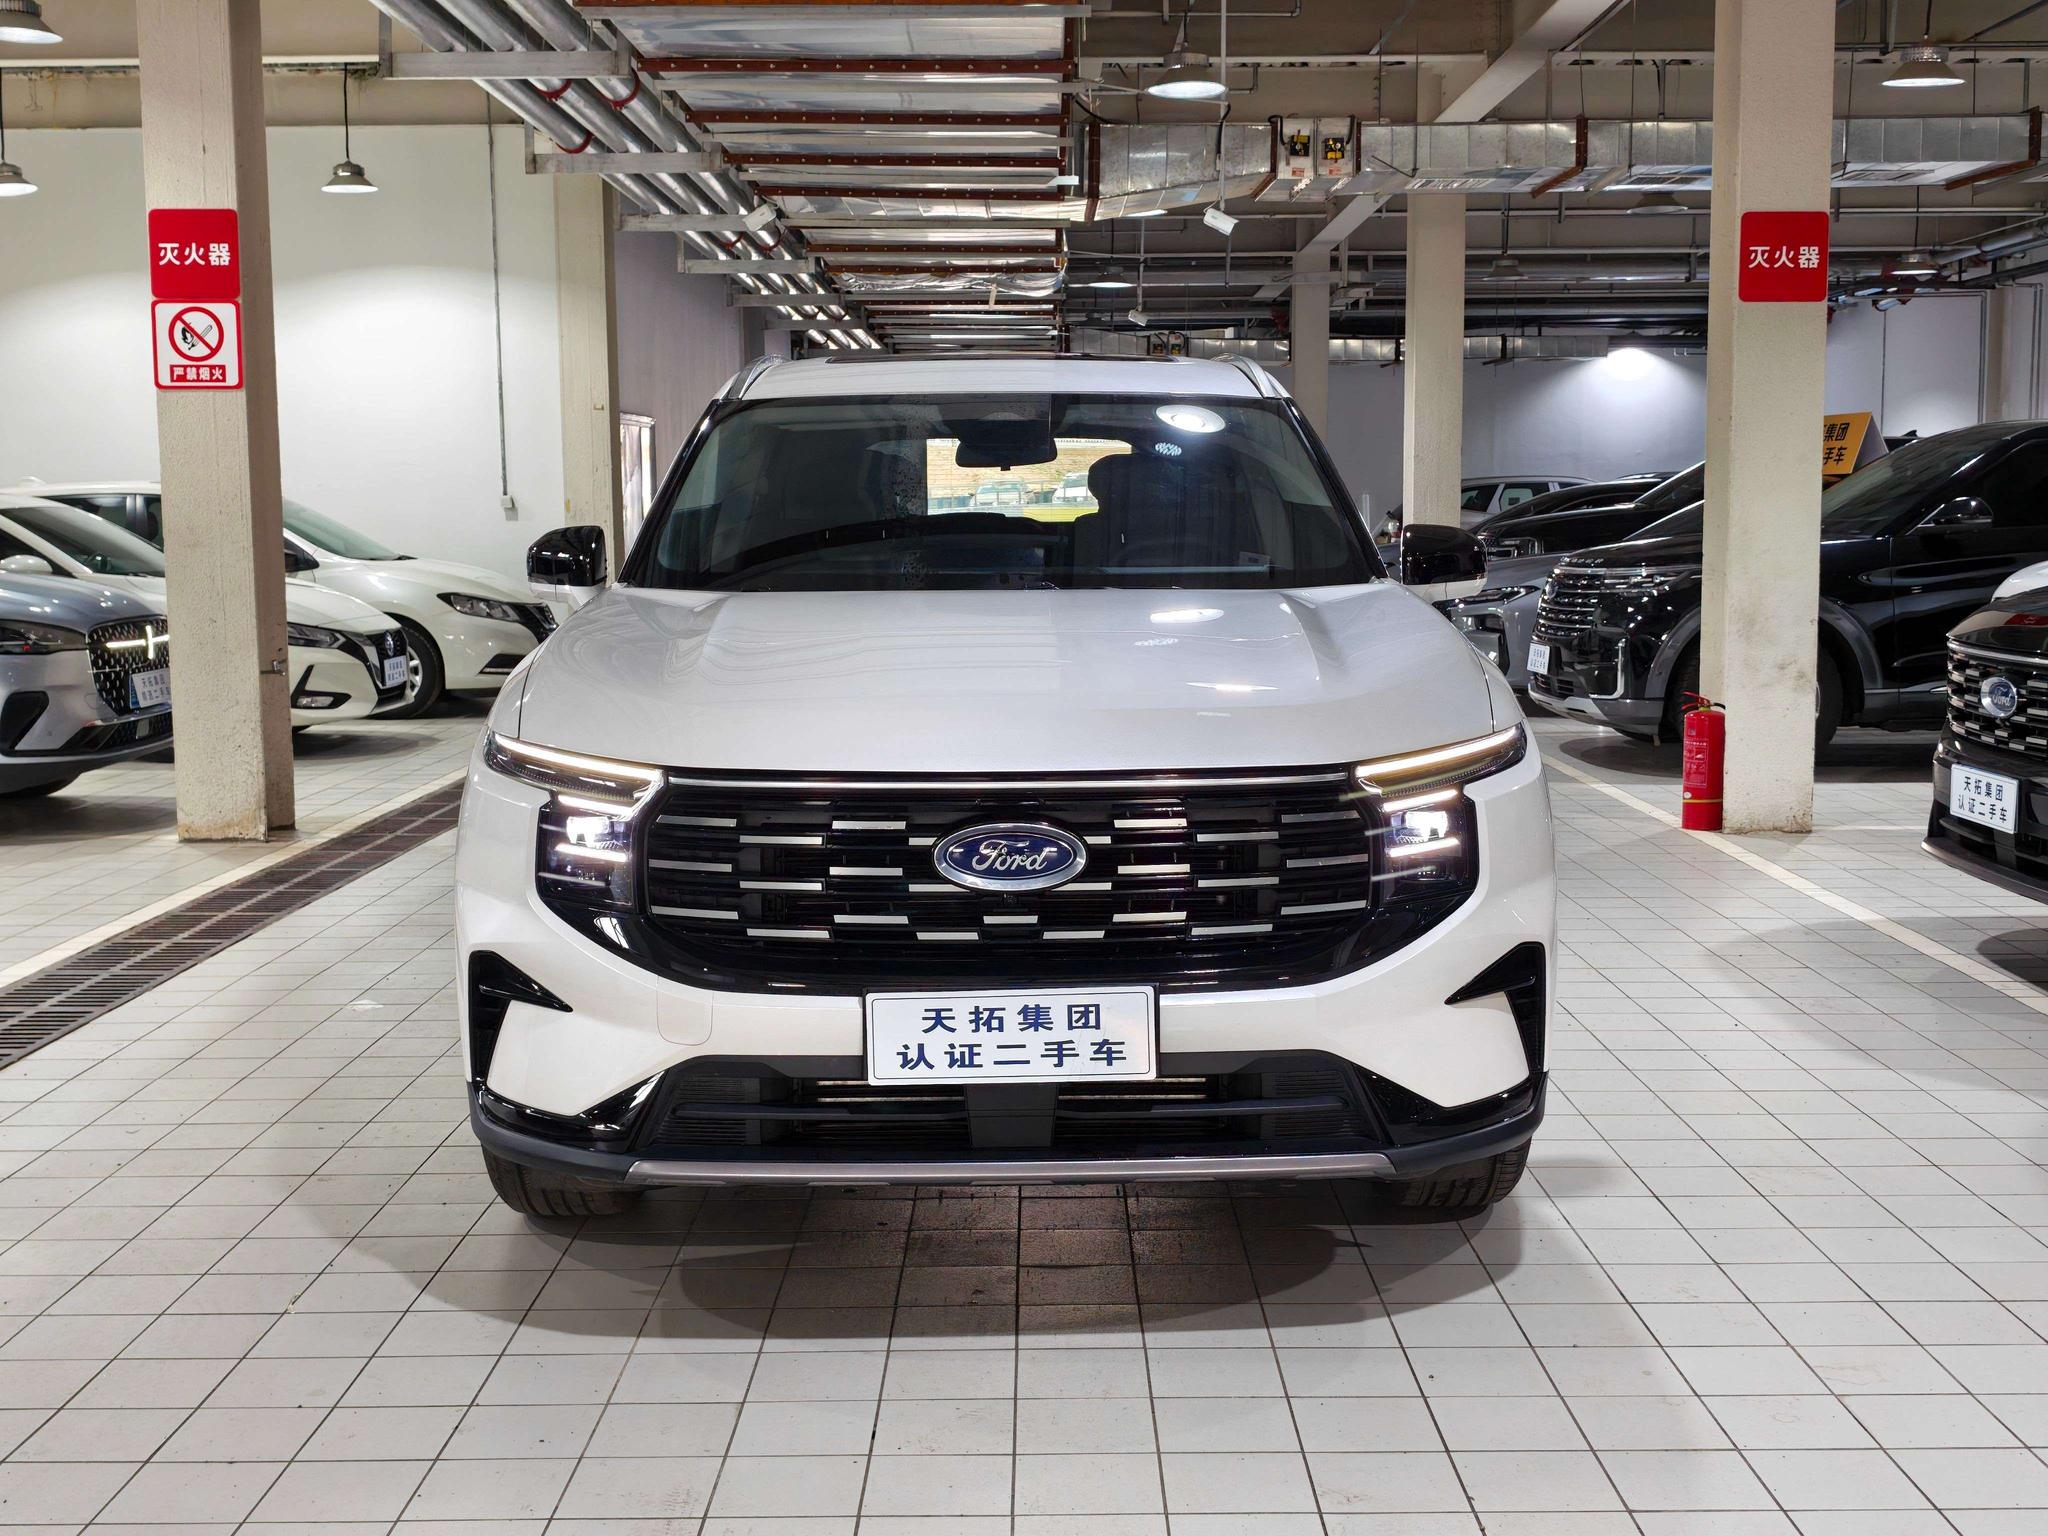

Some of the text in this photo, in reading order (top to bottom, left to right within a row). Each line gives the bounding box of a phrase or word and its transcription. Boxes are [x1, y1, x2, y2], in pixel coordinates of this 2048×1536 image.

[158, 242, 231, 266] 灭火器
[1748, 245, 1820, 268] 灭火器
[173, 366, 223, 381] 严禁烟火
[1963, 776, 2003, 802] 天拓集团
[1957, 794, 2007, 823] 认证二手车
[971, 839, 1048, 870] Ford
[921, 1003, 1101, 1033] 天拓集团
[896, 1038, 1127, 1070] 认证二手车
